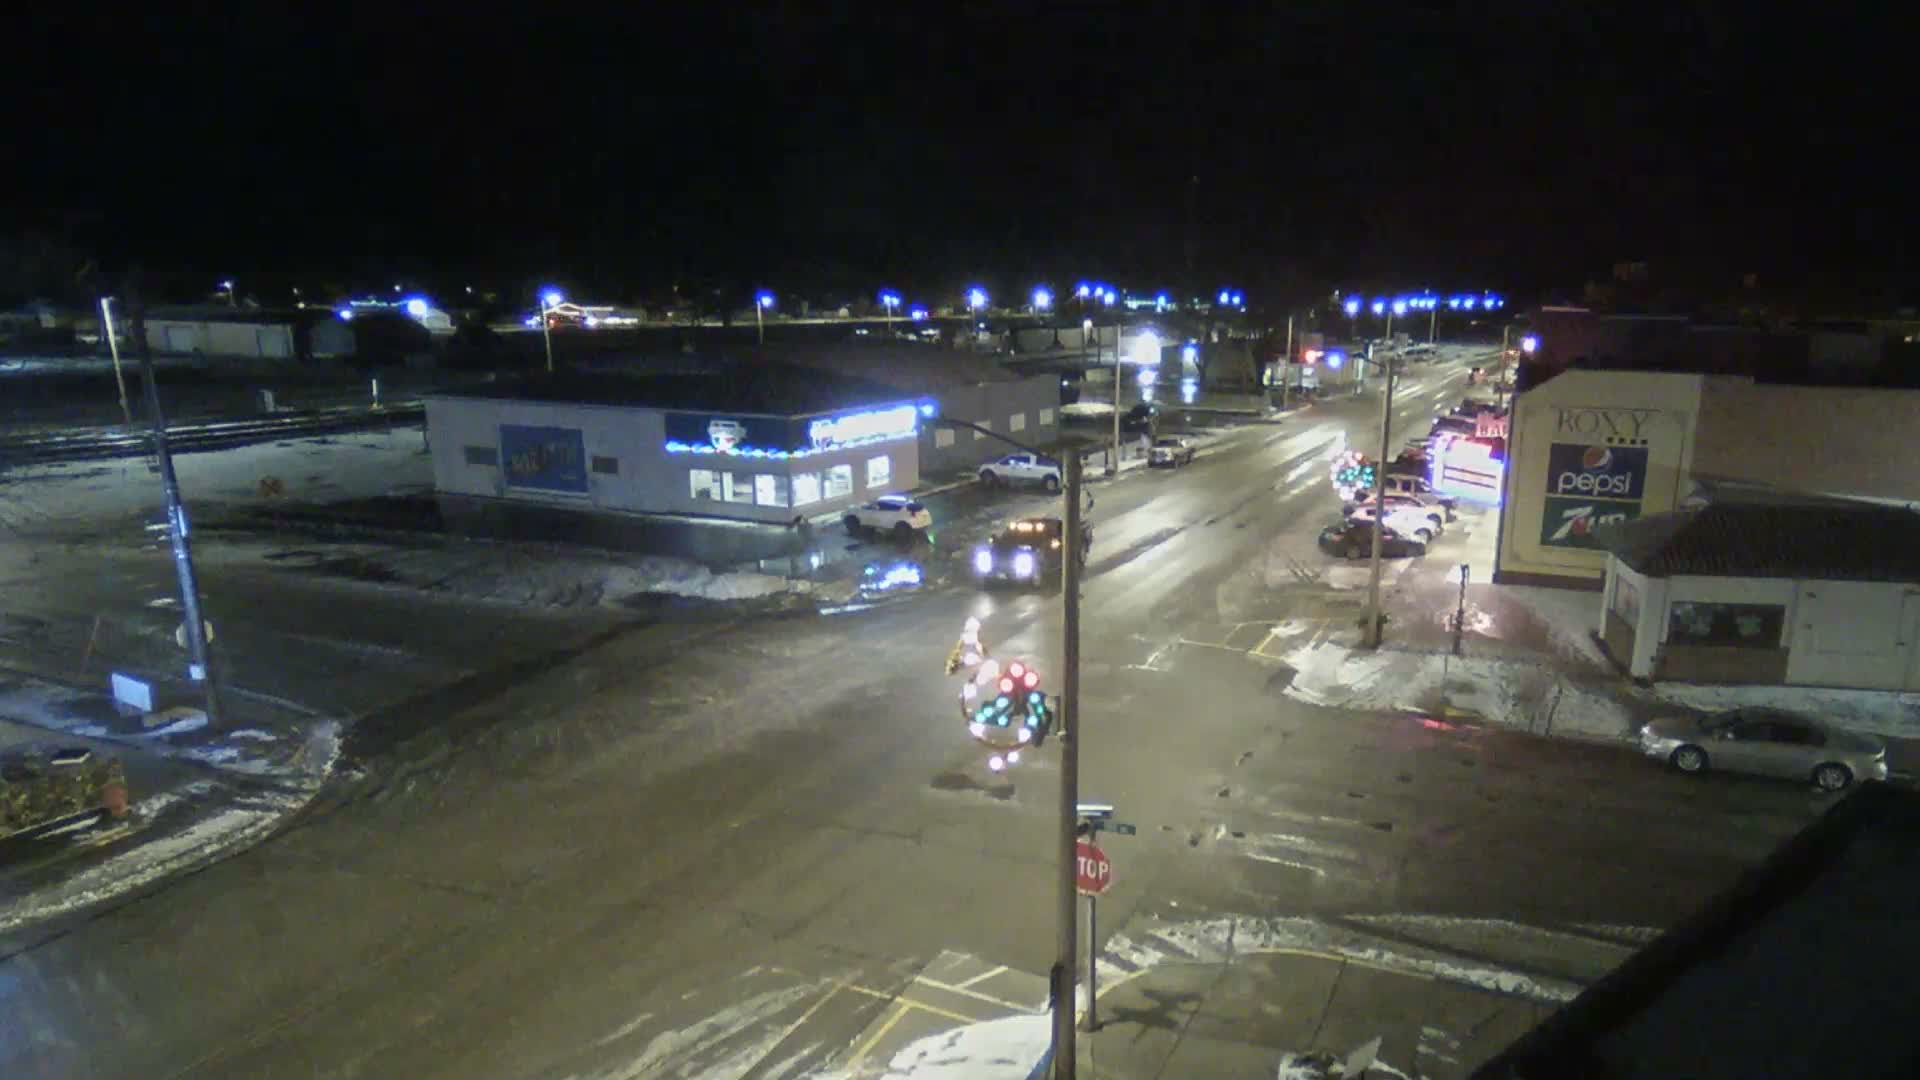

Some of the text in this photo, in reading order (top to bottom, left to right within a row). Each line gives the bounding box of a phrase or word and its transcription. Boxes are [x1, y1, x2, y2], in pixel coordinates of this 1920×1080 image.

[1557, 409, 1649, 436] ROXY
[1558, 471, 1632, 497] pepsi
[1077, 856, 1110, 880] TOP
